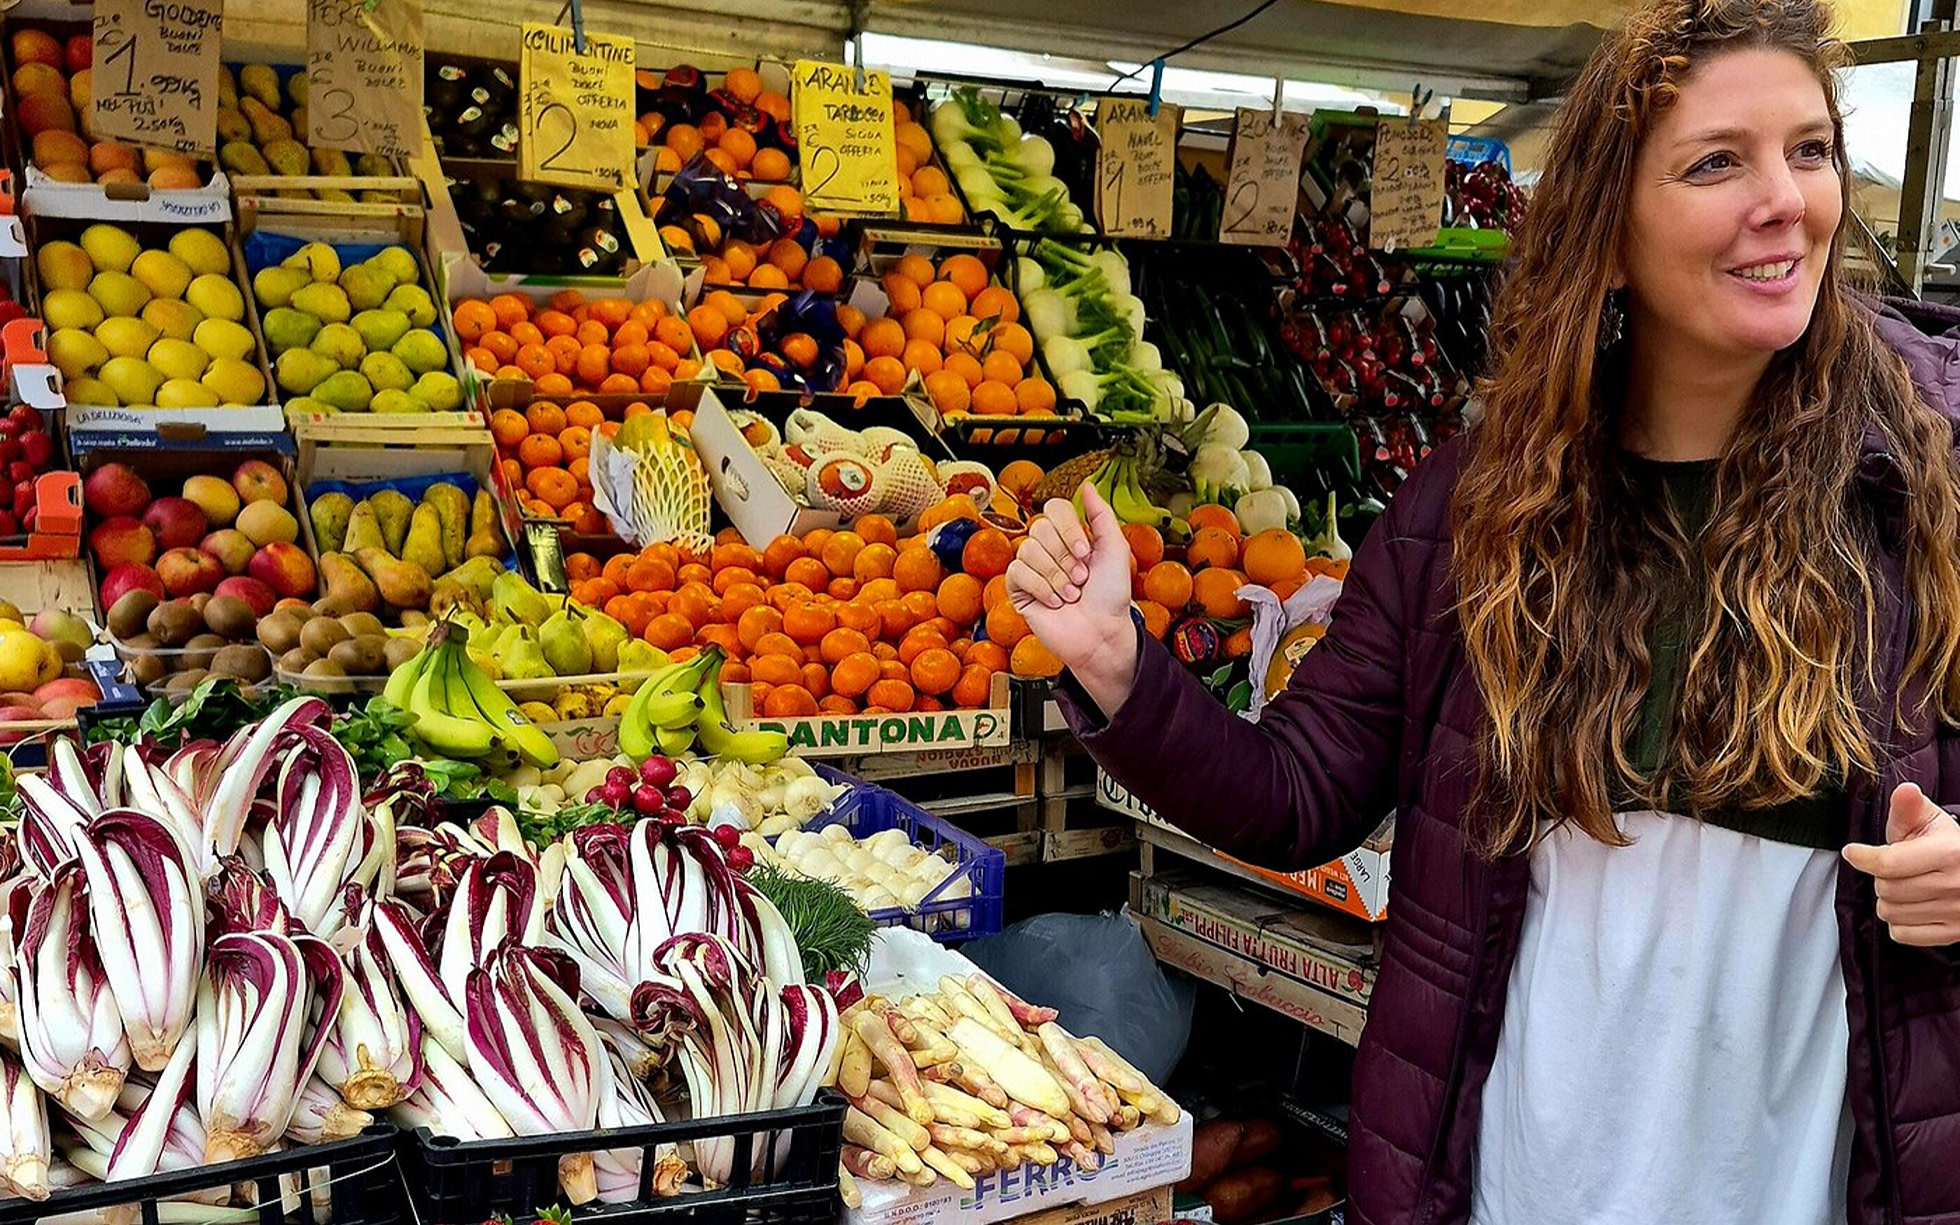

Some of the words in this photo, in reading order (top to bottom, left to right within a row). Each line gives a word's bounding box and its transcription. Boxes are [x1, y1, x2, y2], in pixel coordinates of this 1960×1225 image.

[105, 33, 141, 97] 1
[314, 88, 359, 141] 3
[536, 103, 592, 175] 2
[808, 145, 863, 203] 2
[1105, 160, 1125, 232] 1
[1223, 181, 1260, 234] 2
[1350, 851, 1370, 883] LARGE
[1302, 955, 1338, 989] ALTA
